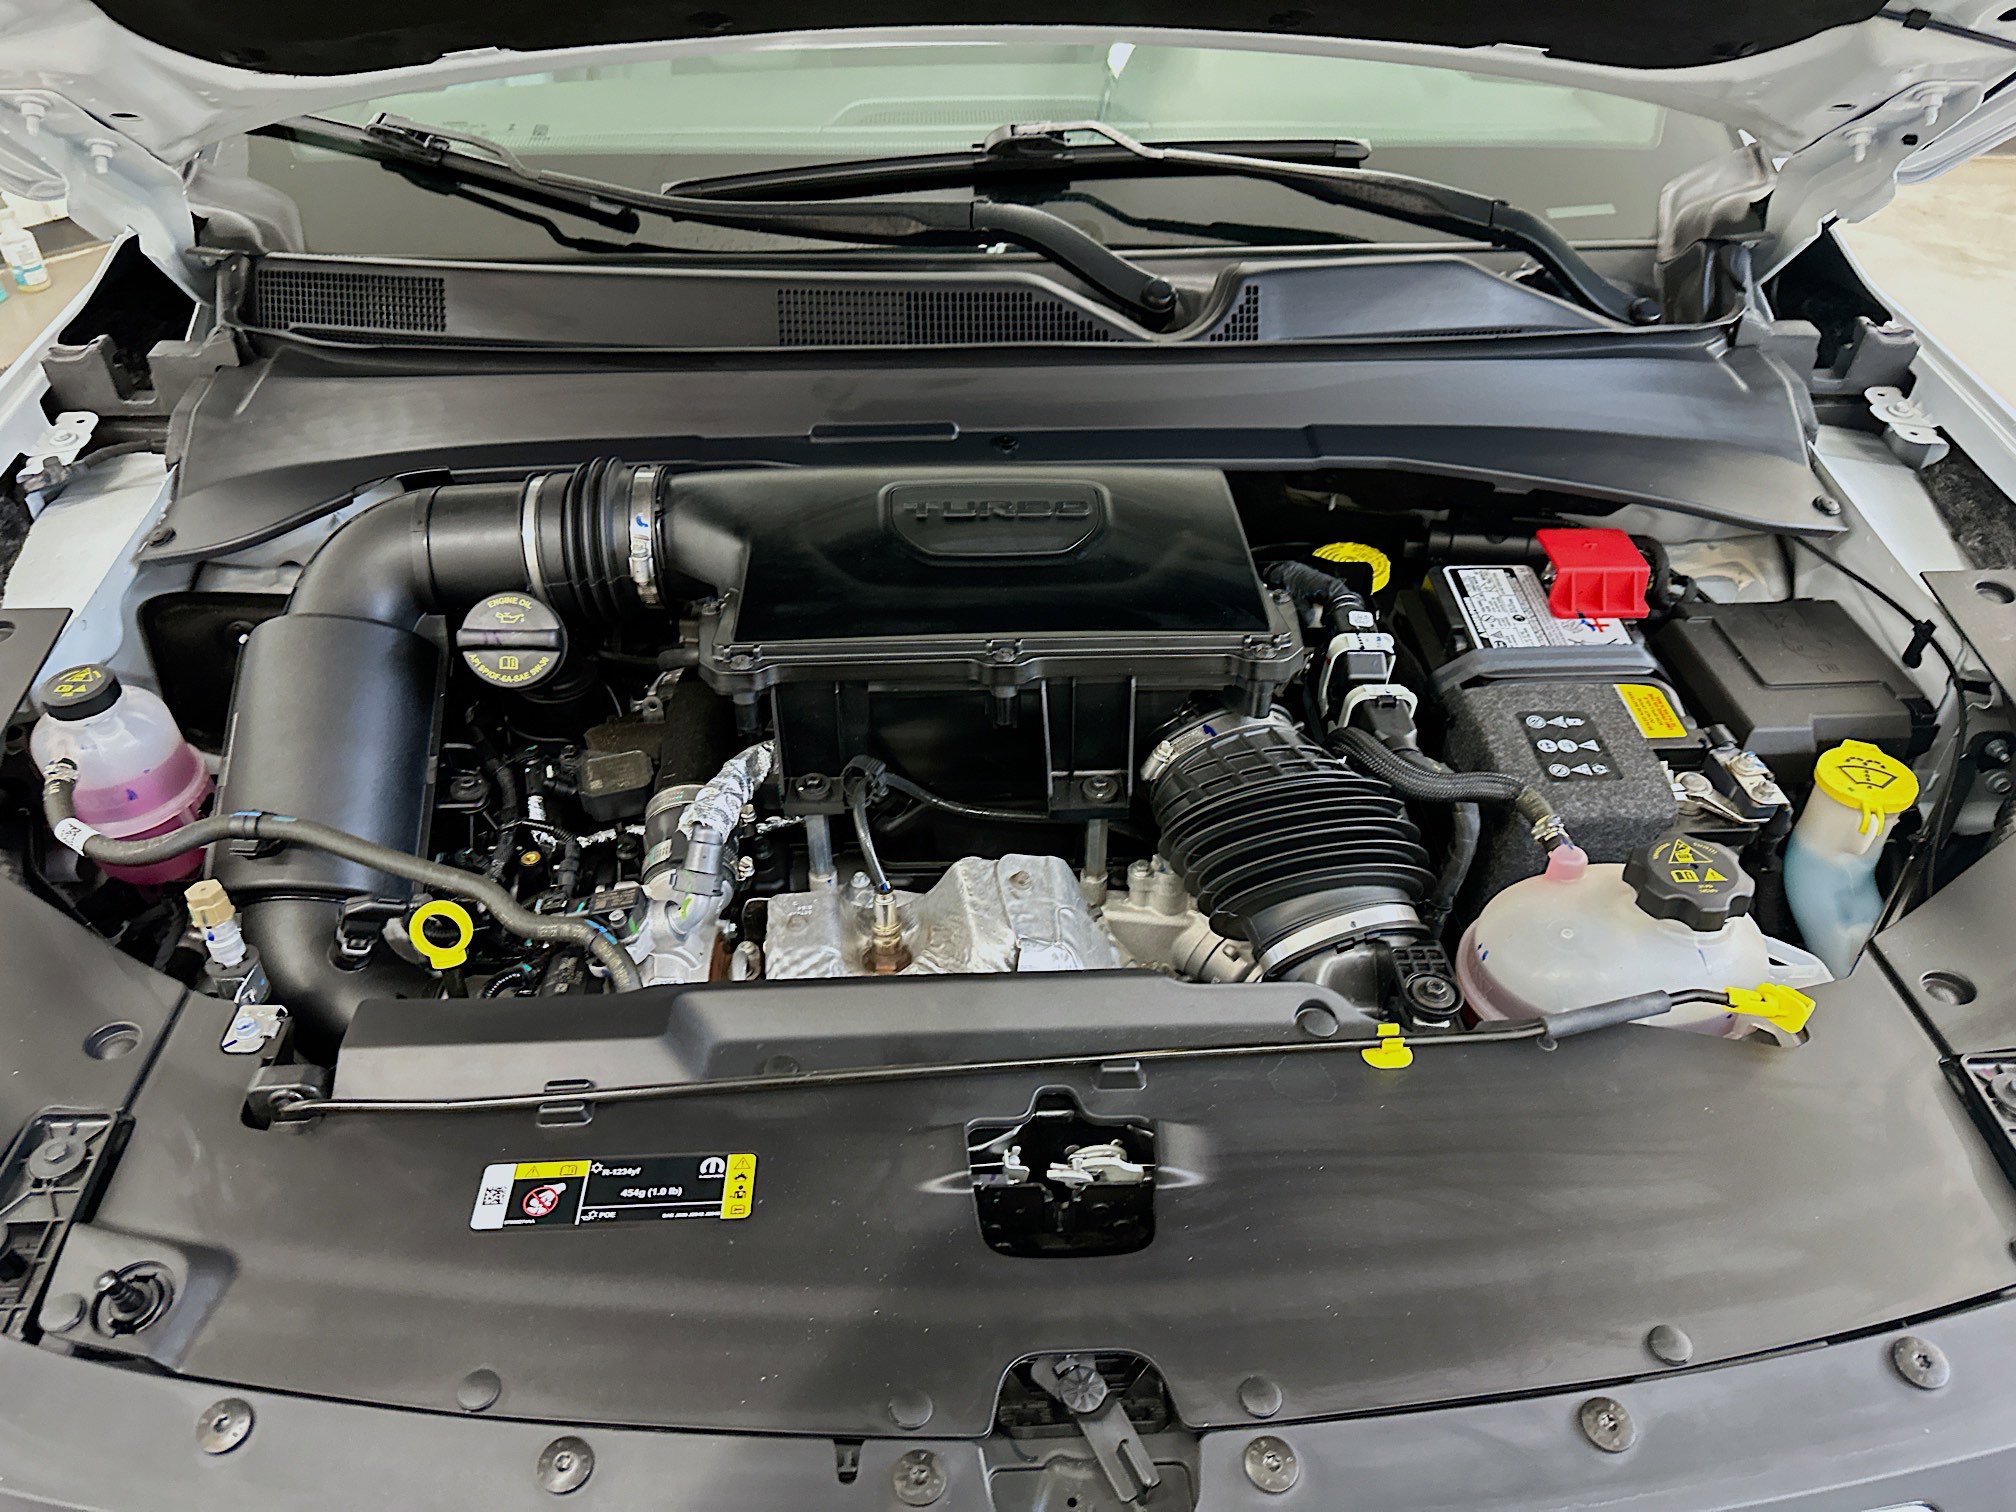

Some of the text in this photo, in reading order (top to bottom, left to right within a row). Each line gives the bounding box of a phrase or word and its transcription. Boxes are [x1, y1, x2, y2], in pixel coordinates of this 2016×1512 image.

[903, 501, 1092, 518] TURBO
[488, 597, 533, 609] ENGINE OIL
[601, 1167, 641, 1176] R-1234yf
[620, 1186, 683, 1198] 454g (1.0 lb)
[599, 1211, 617, 1219] POE
